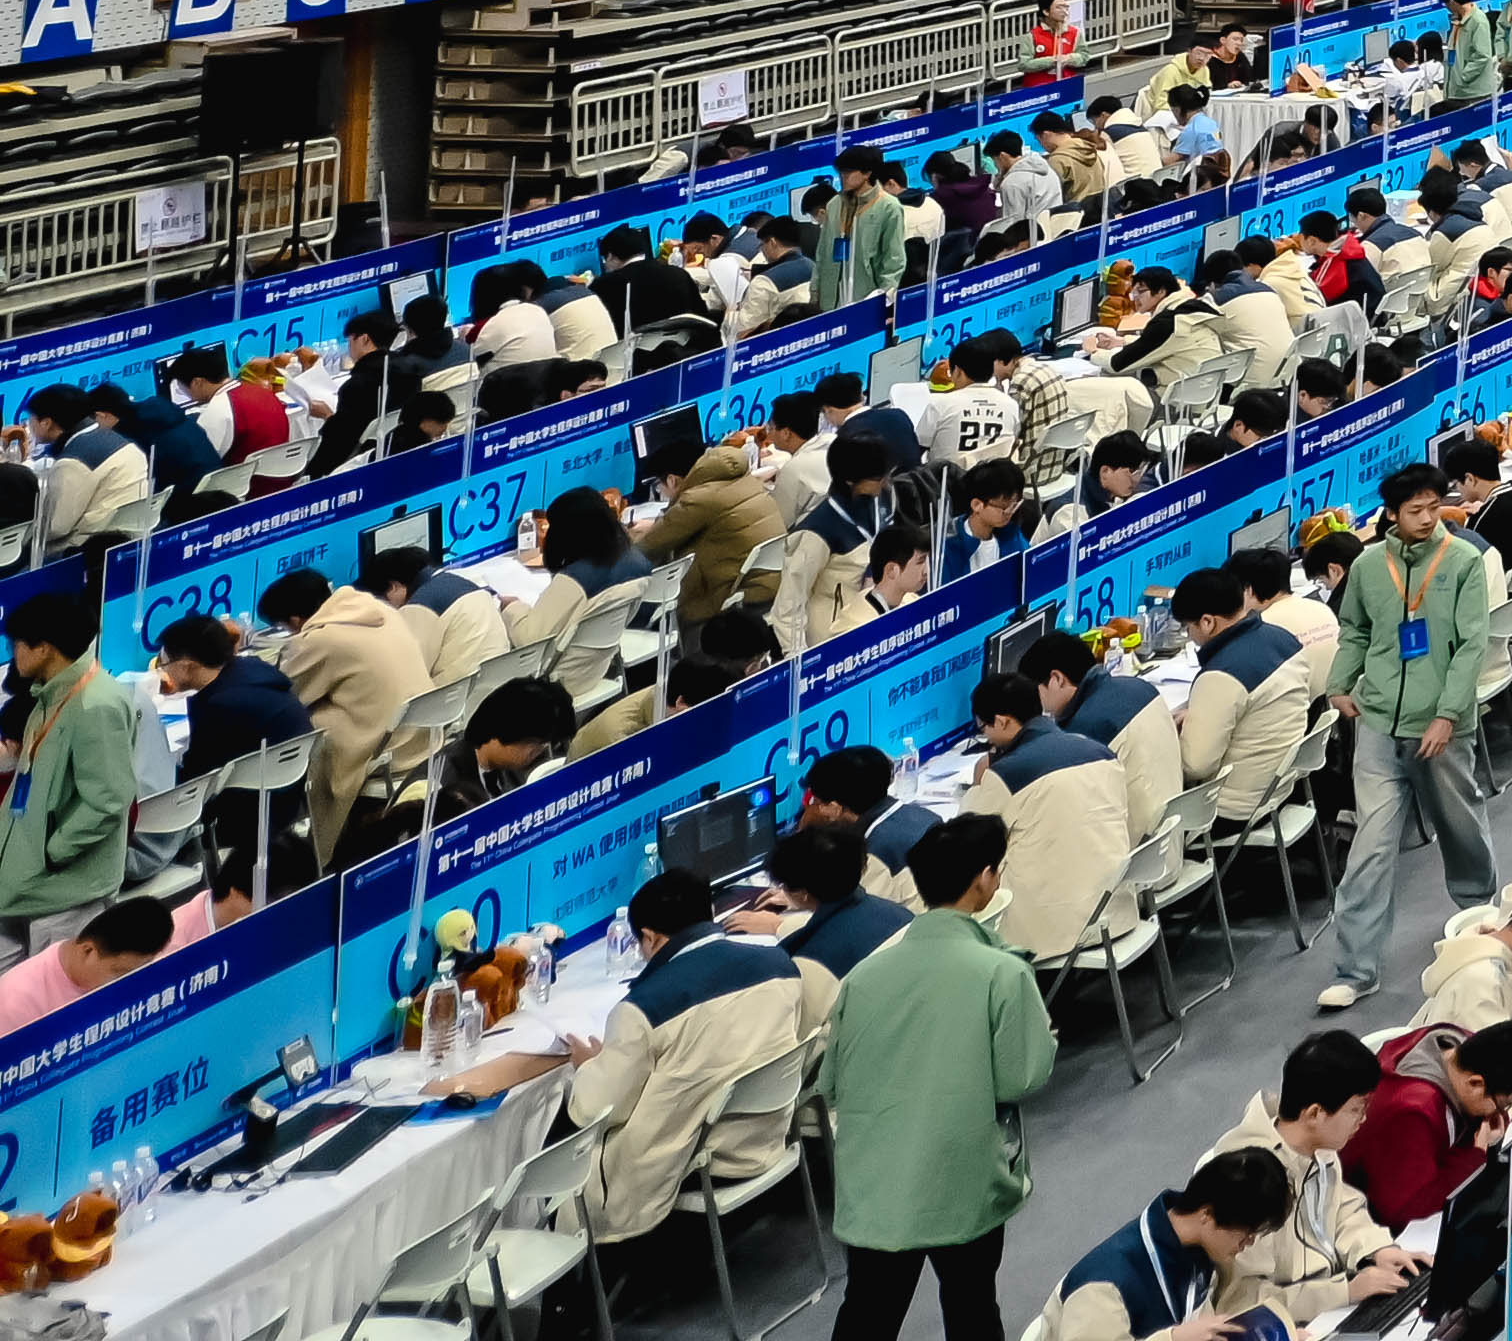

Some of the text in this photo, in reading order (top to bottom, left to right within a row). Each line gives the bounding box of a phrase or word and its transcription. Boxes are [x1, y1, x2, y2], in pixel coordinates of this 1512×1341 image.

[235, 316, 305, 369] C15
[704, 386, 767, 443] C36
[963, 407, 1004, 419] MINA
[448, 472, 528, 541] C37
[141, 573, 233, 654] C38
[572, 840, 595, 869] WA
[387, 888, 501, 1000] C0
[88, 1056, 210, 1149] 备用赛位
